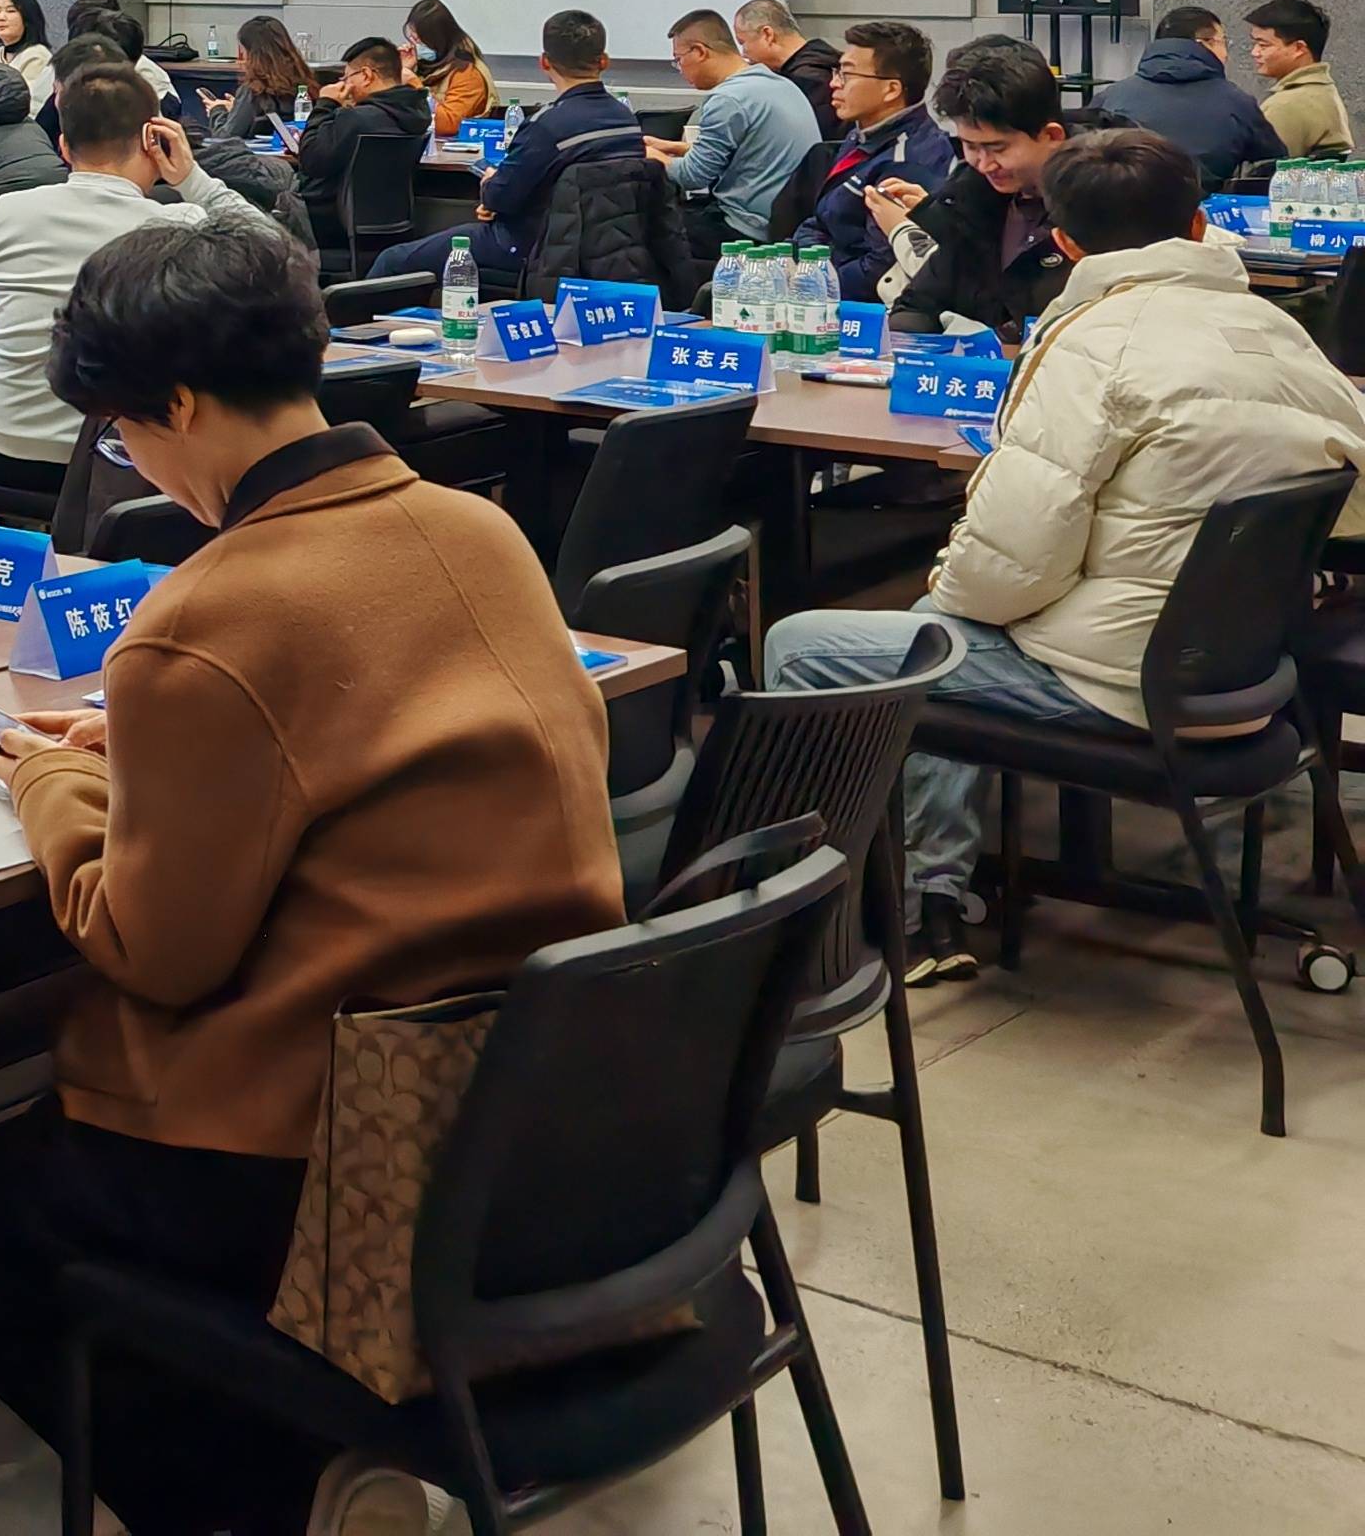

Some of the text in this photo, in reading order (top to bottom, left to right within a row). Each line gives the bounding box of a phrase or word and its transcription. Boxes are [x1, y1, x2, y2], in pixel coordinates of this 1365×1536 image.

[671, 346, 740, 371] 张志兵
[916, 374, 997, 401] 刘永贵
